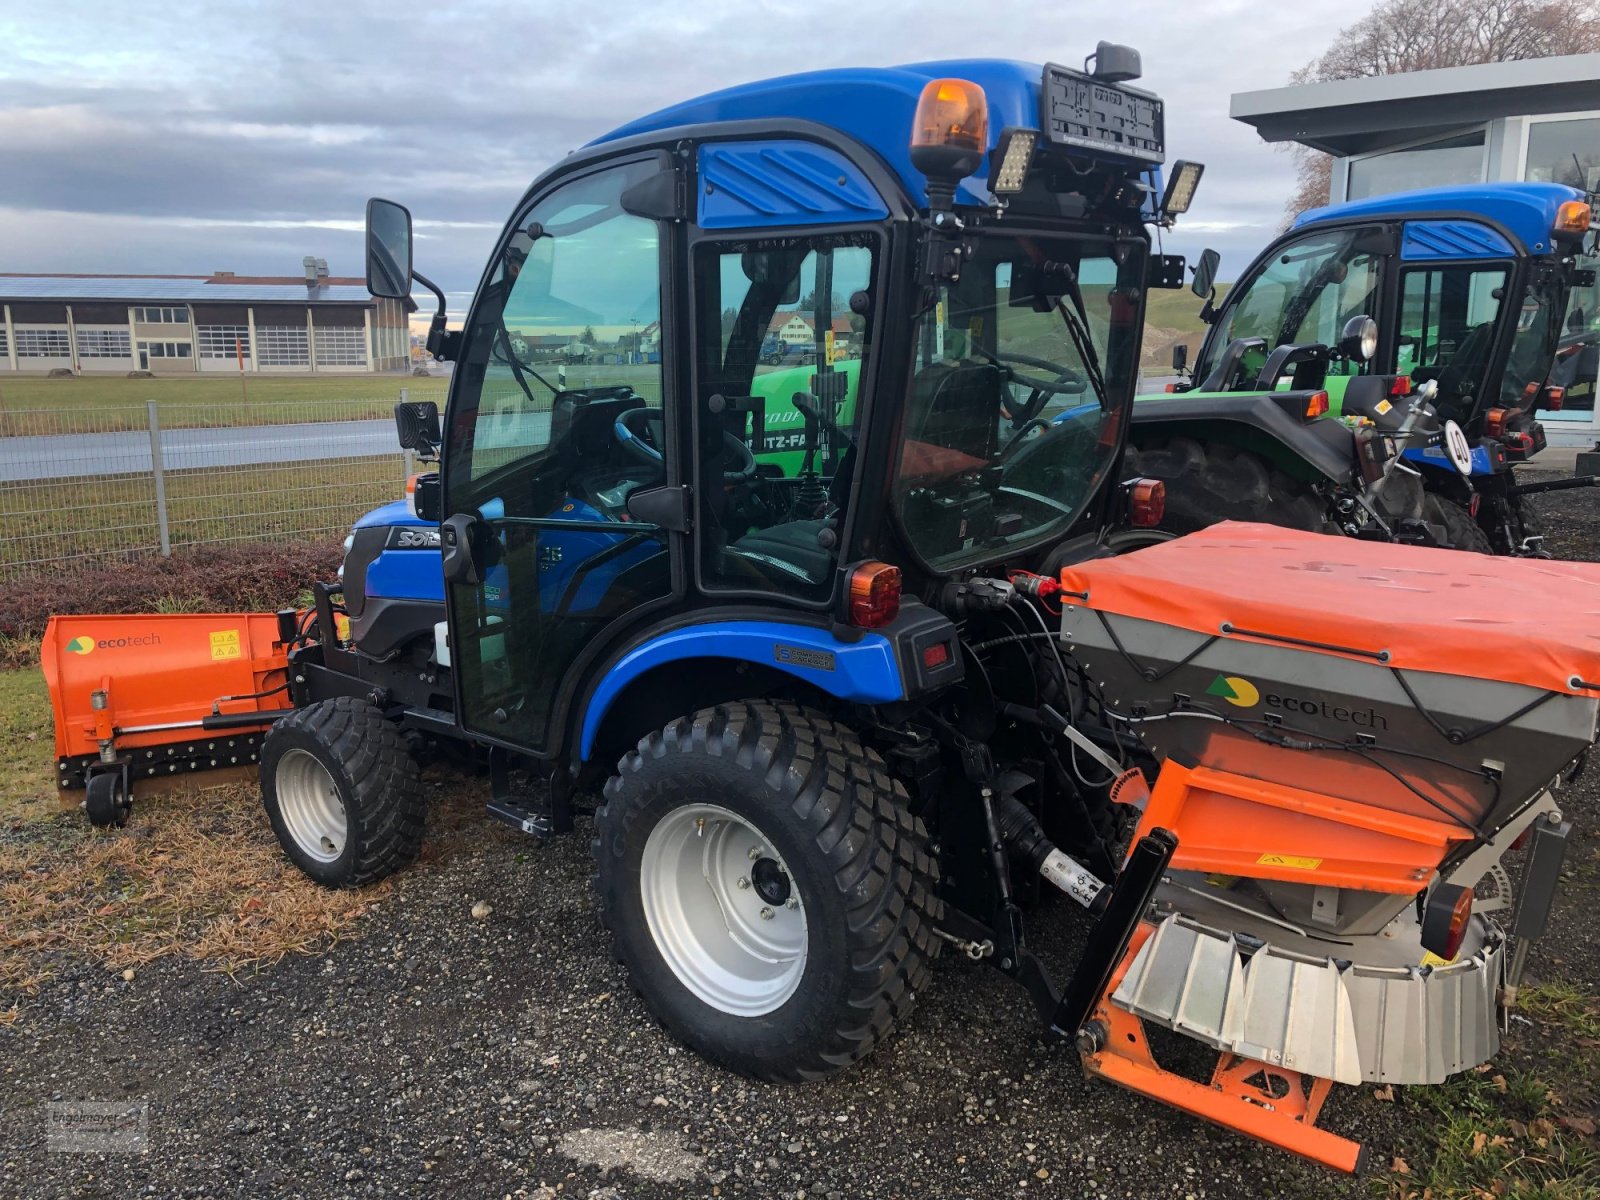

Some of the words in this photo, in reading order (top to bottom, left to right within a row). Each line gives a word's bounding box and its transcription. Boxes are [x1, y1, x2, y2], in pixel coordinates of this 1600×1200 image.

[1450, 430, 1468, 464] 40
[97, 633, 161, 649] ecotech
[1265, 693, 1389, 730] ecotech
